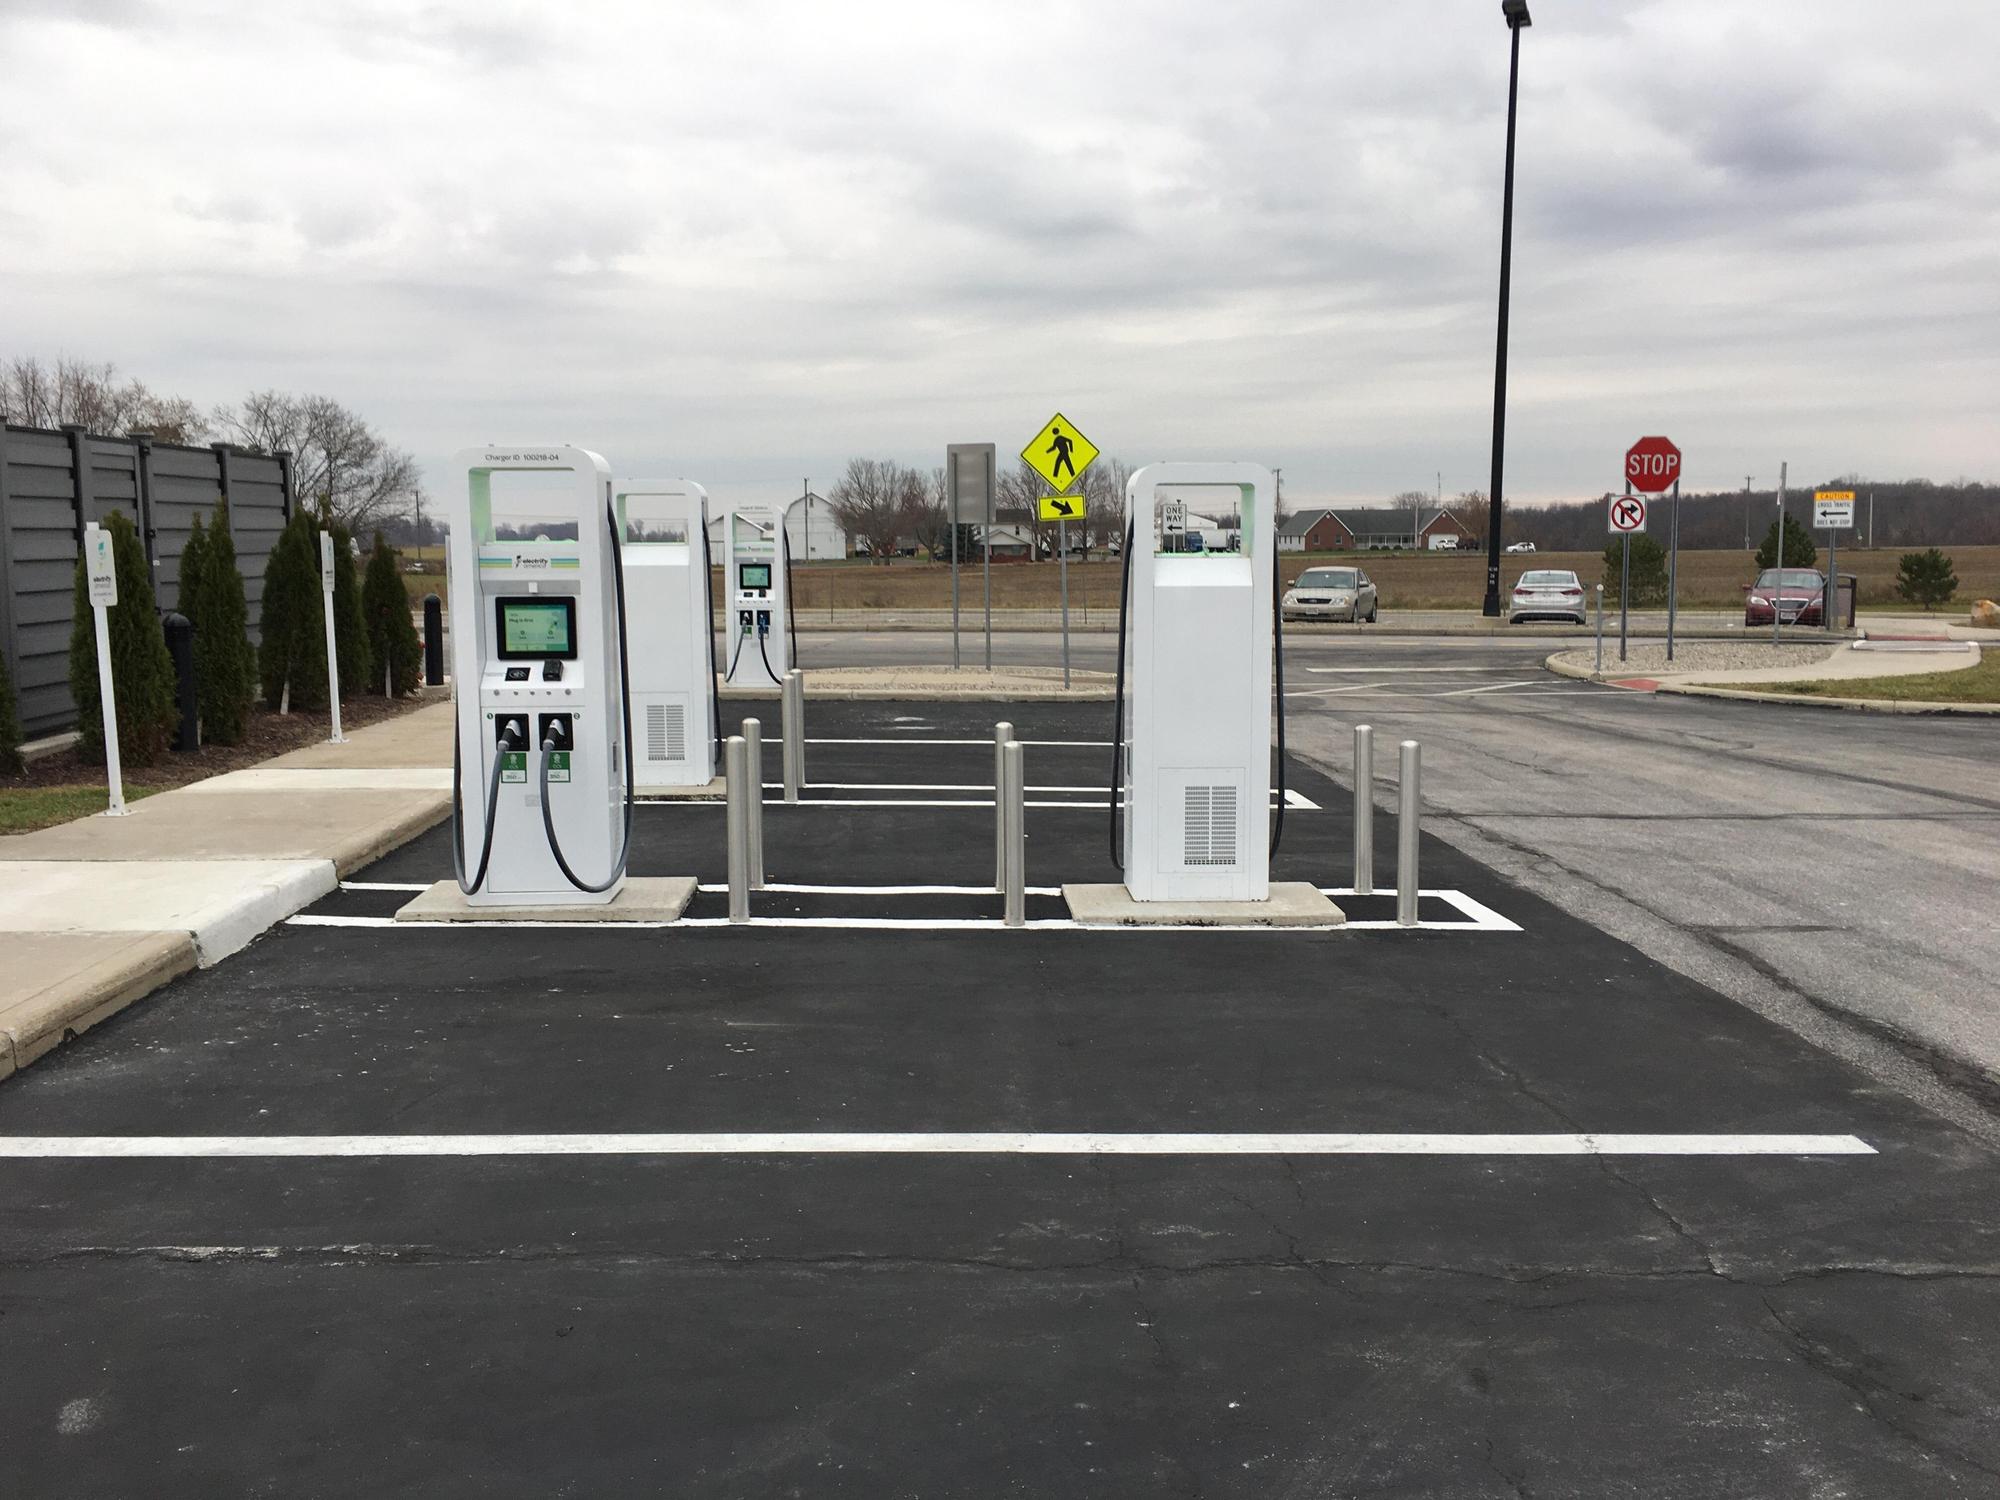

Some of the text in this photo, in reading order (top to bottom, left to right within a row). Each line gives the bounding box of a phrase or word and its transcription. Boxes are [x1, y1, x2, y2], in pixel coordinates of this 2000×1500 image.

[485, 454, 511, 462] Charger
[1629, 454, 1678, 475] STOP
[1166, 506, 1182, 514] ONE
